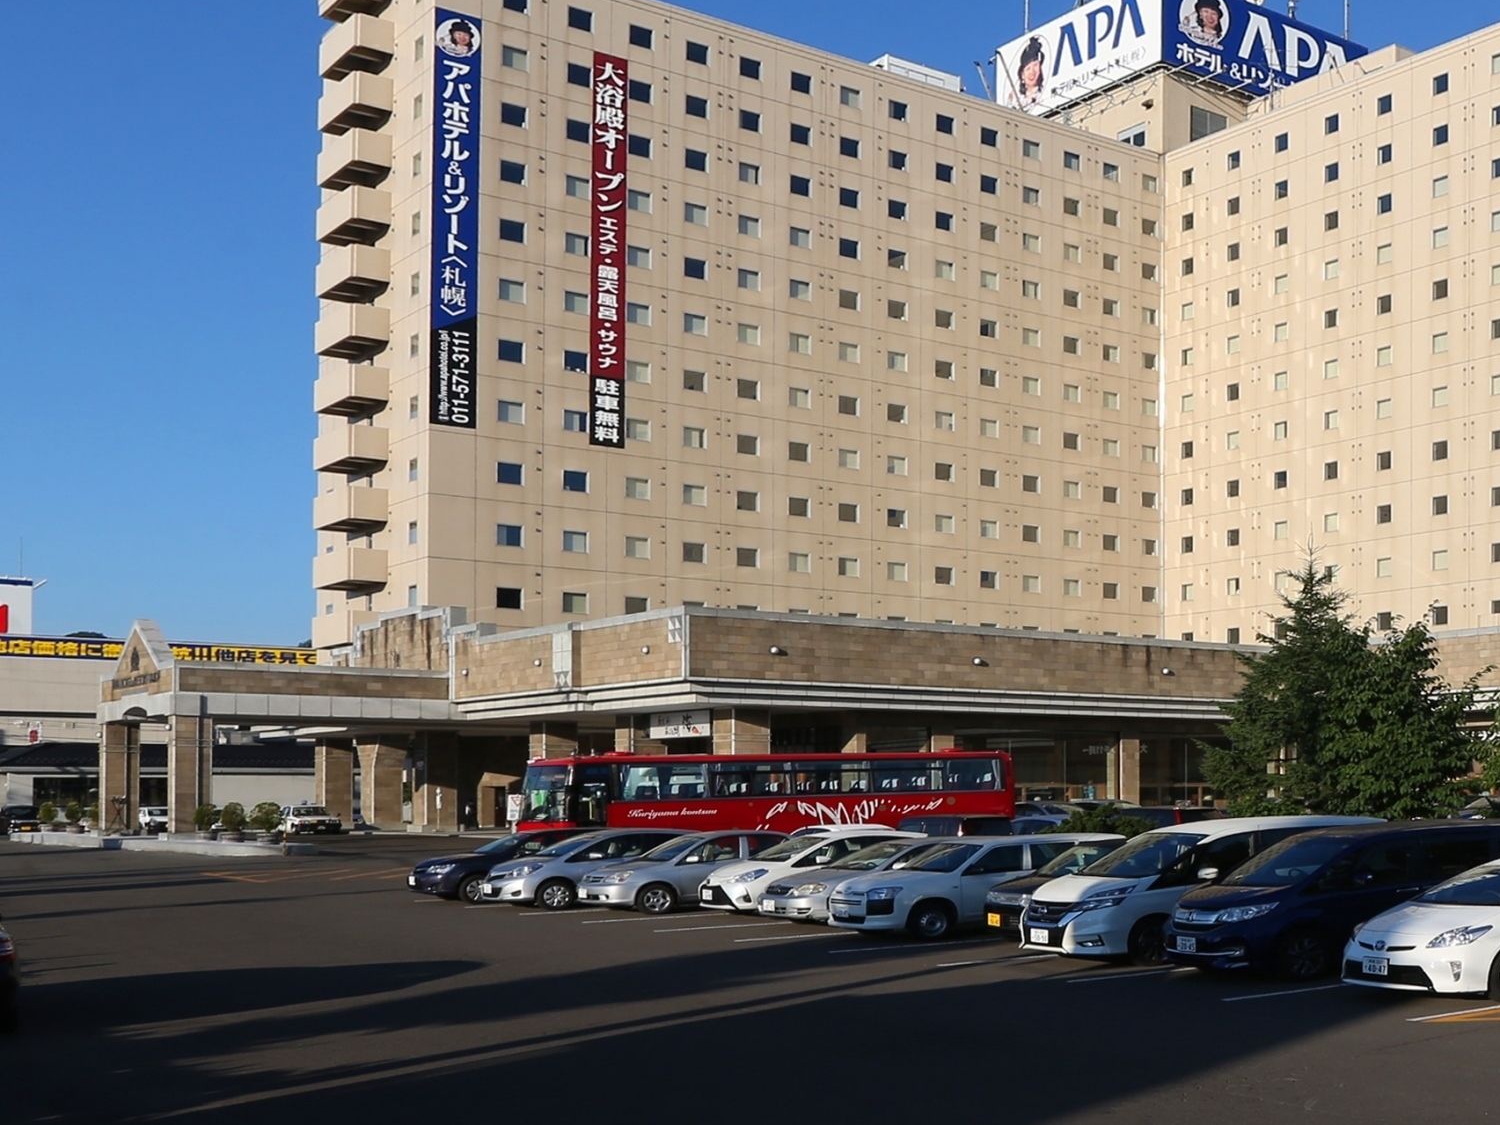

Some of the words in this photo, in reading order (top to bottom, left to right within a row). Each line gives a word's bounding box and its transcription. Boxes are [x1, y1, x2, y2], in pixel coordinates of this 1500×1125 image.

[1238, 10, 1348, 79] APA
[451, 331, 470, 424] 011-571-3111
[594, 378, 620, 443] 駐車無料
[627, 808, 679, 820] Kuriyama
